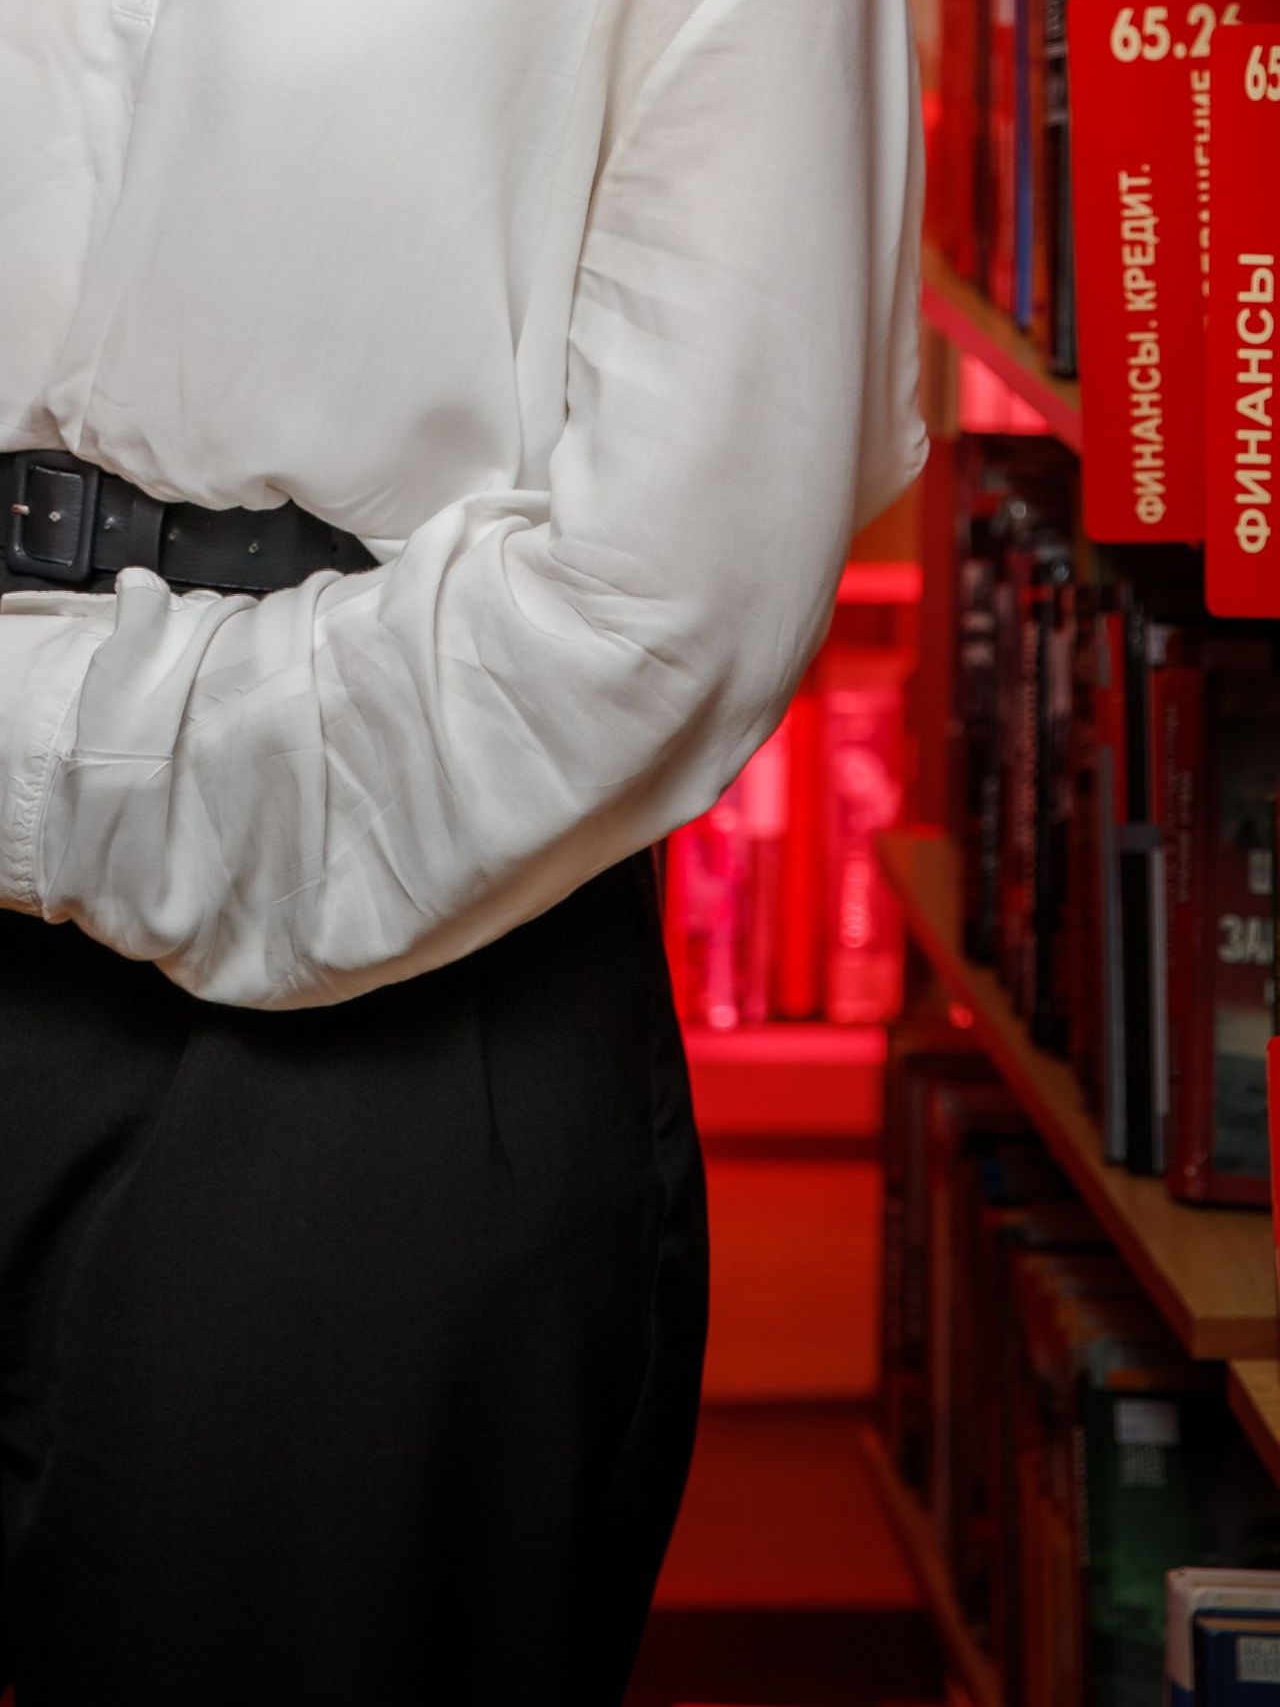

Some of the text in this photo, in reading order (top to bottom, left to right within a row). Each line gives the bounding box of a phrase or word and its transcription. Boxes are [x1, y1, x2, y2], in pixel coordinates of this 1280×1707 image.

[1119, 163, 1166, 524] ФИНАНСЫ. КРЕДИТ.
[1235, 253, 1276, 553] ФИНАНСЫ
